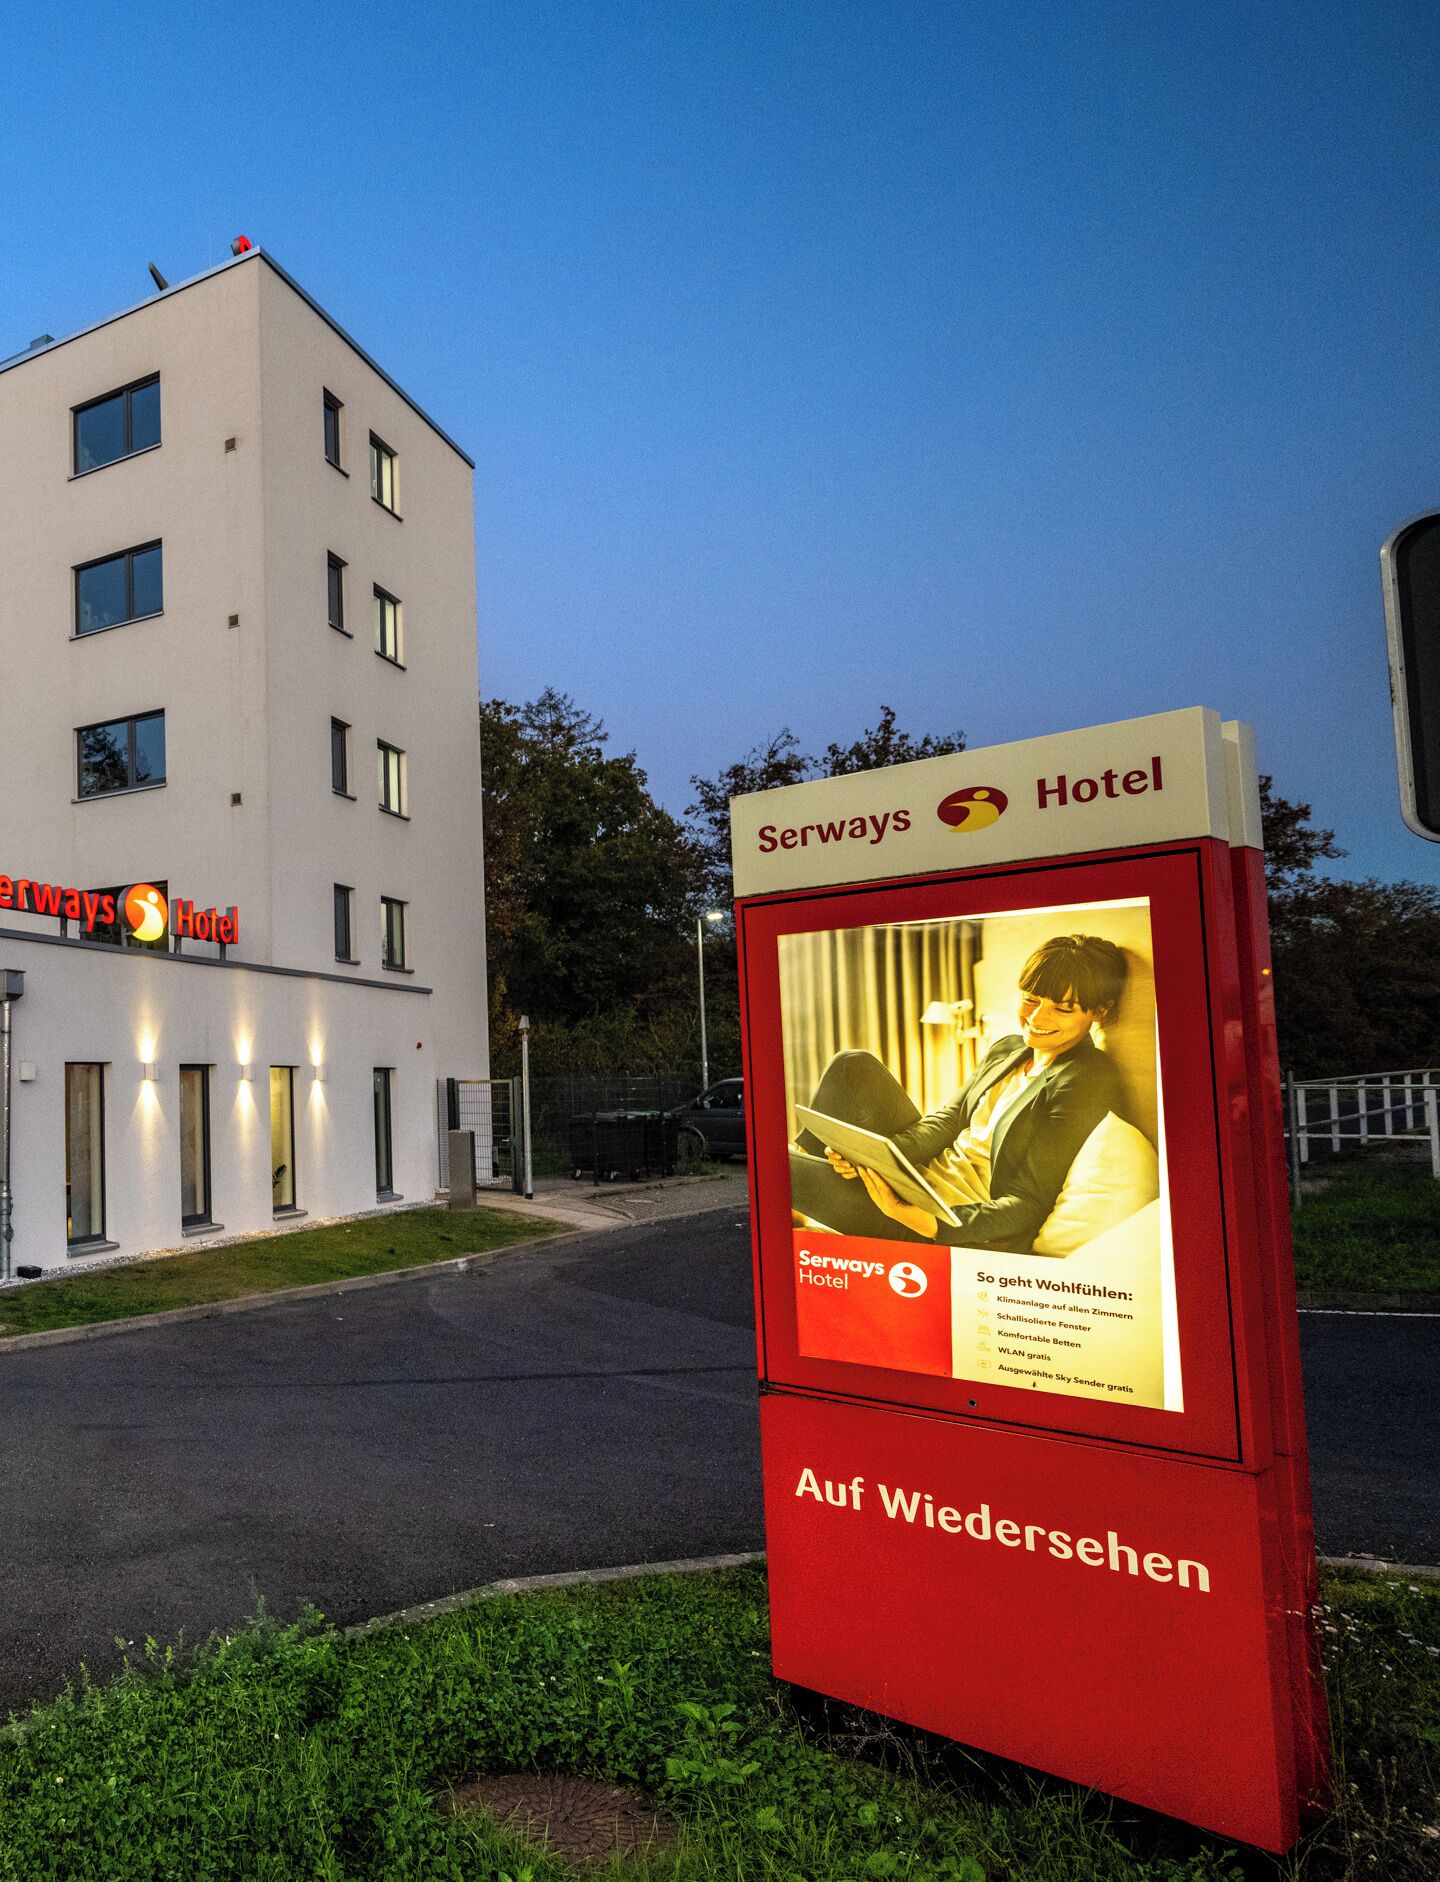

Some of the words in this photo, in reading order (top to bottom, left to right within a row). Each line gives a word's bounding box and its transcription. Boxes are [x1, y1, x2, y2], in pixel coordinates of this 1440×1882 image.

[758, 809, 911, 853] Serways
[1037, 756, 1163, 809] Hotel
[175, 897, 239, 945] Hotel
[799, 1250, 885, 1278] Serways
[799, 1268, 848, 1289] Hotel
[977, 1272, 995, 1283] So
[998, 1276, 1032, 1288] geht
[1035, 1279, 1133, 1301] Wohlfühlen:
[997, 1295, 1050, 1309] Klimaanlage
[1068, 1306, 1090, 1314] allen
[1092, 1308, 1134, 1320] Zimmern
[997, 1312, 1057, 1327] Schallisolierte
[1058, 1321, 1091, 1332] Fenster
[997, 1329, 1051, 1344] Komfortable
[1053, 1338, 1082, 1348] Betten
[998, 1346, 1025, 1357] WLAN
[1027, 1352, 1051, 1361] gratis
[998, 1364, 1054, 1380] Ausgewählte
[1055, 1373, 1072, 1384] Sky
[1073, 1377, 1105, 1388] Sender
[1107, 1382, 1134, 1393] gratis
[795, 1468, 864, 1510] Auf
[877, 1483, 1210, 1593] Wiedersehen
